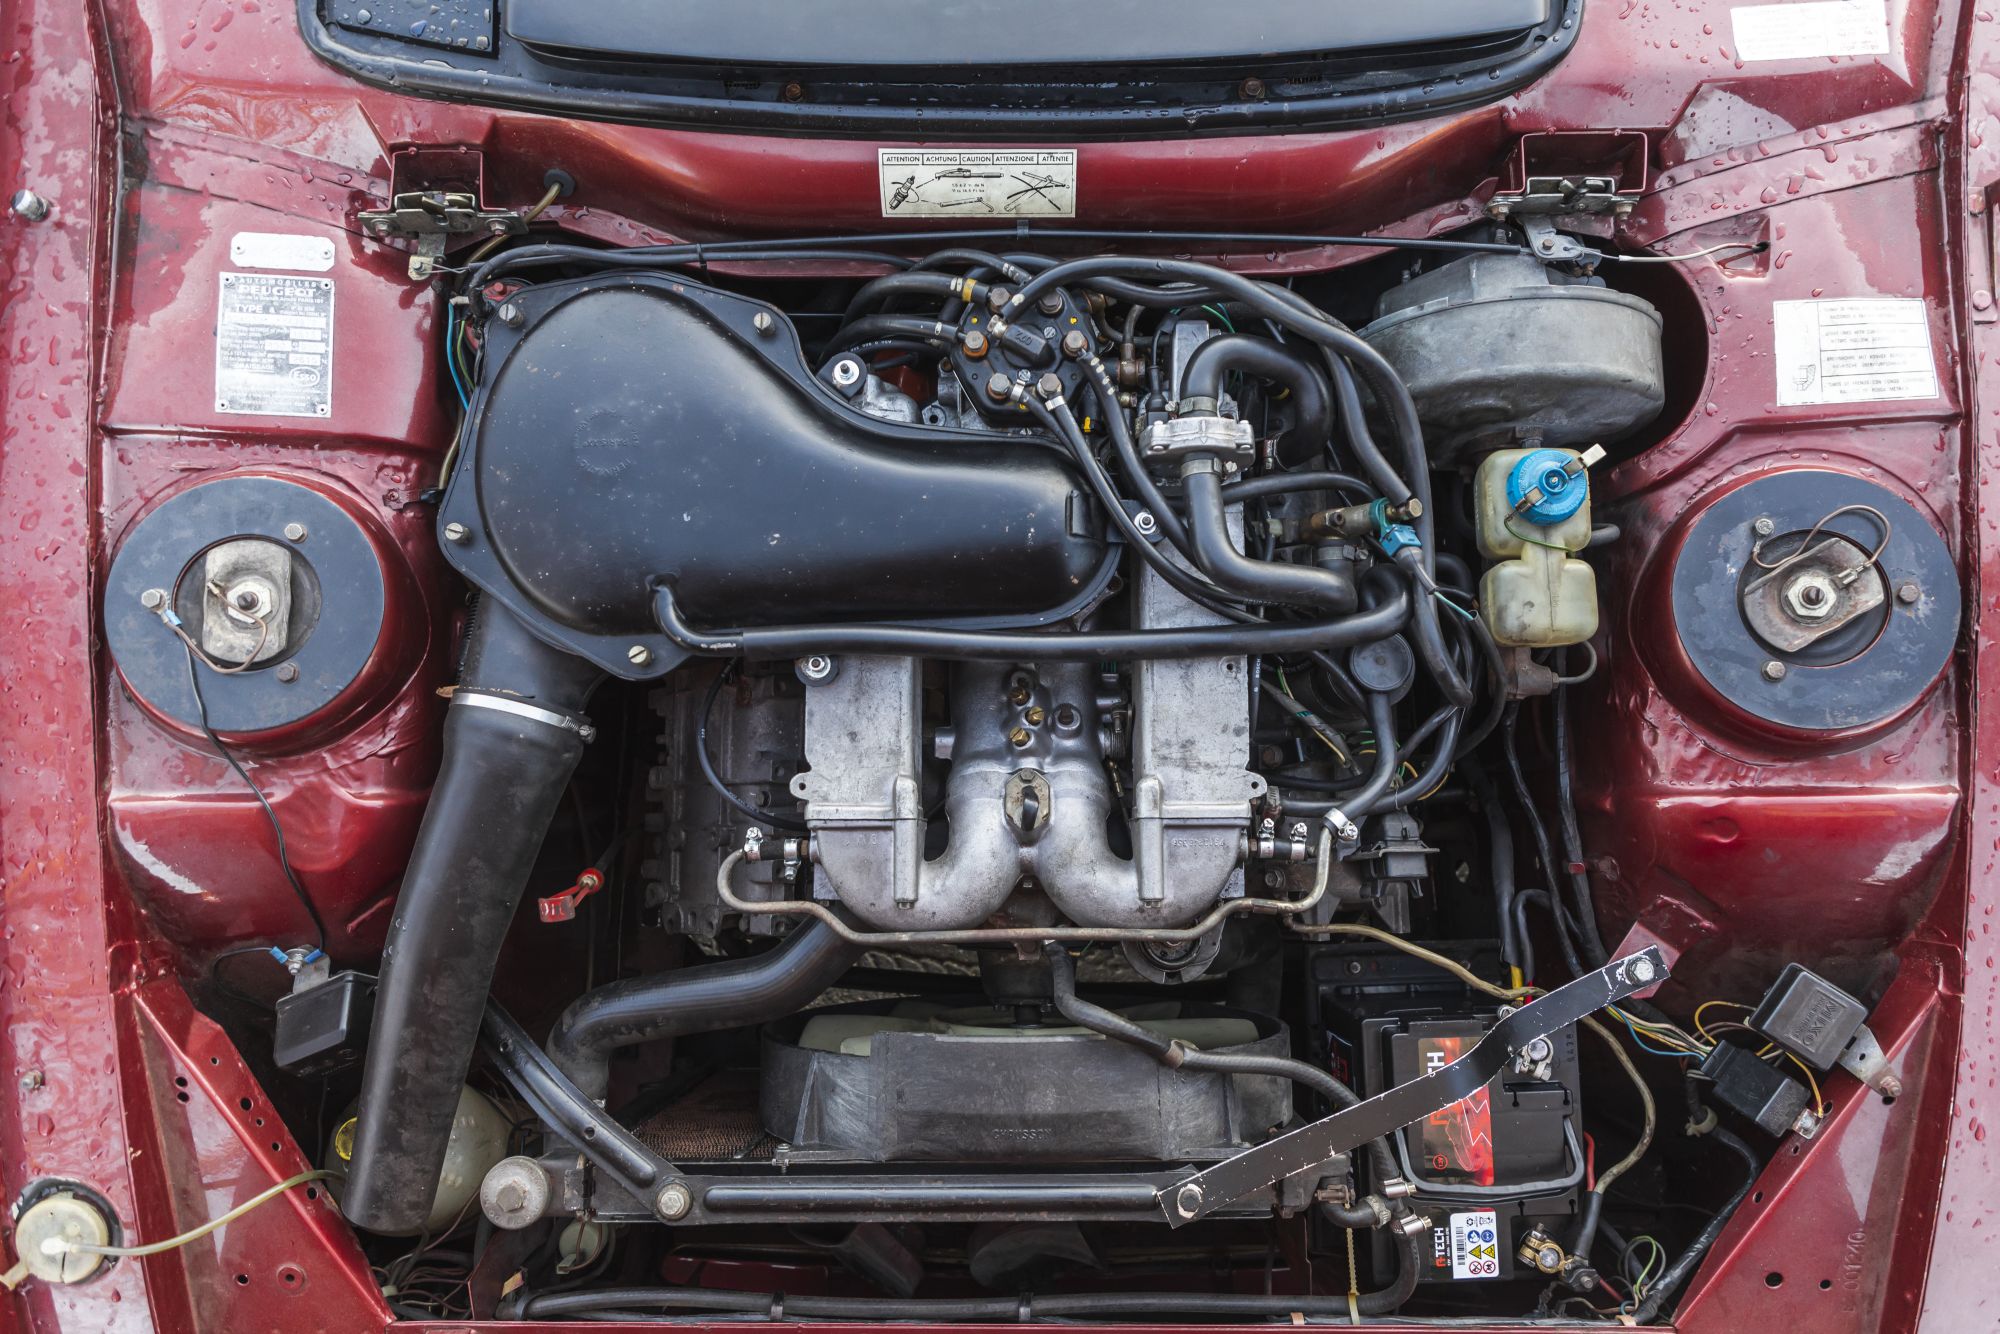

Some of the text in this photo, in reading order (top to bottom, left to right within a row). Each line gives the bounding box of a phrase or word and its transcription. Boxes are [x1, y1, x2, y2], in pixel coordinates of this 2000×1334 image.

[239, 278, 317, 288] AUTOMOBILES
[237, 285, 317, 297] PEUGEOT
[235, 304, 263, 313] TYPE
